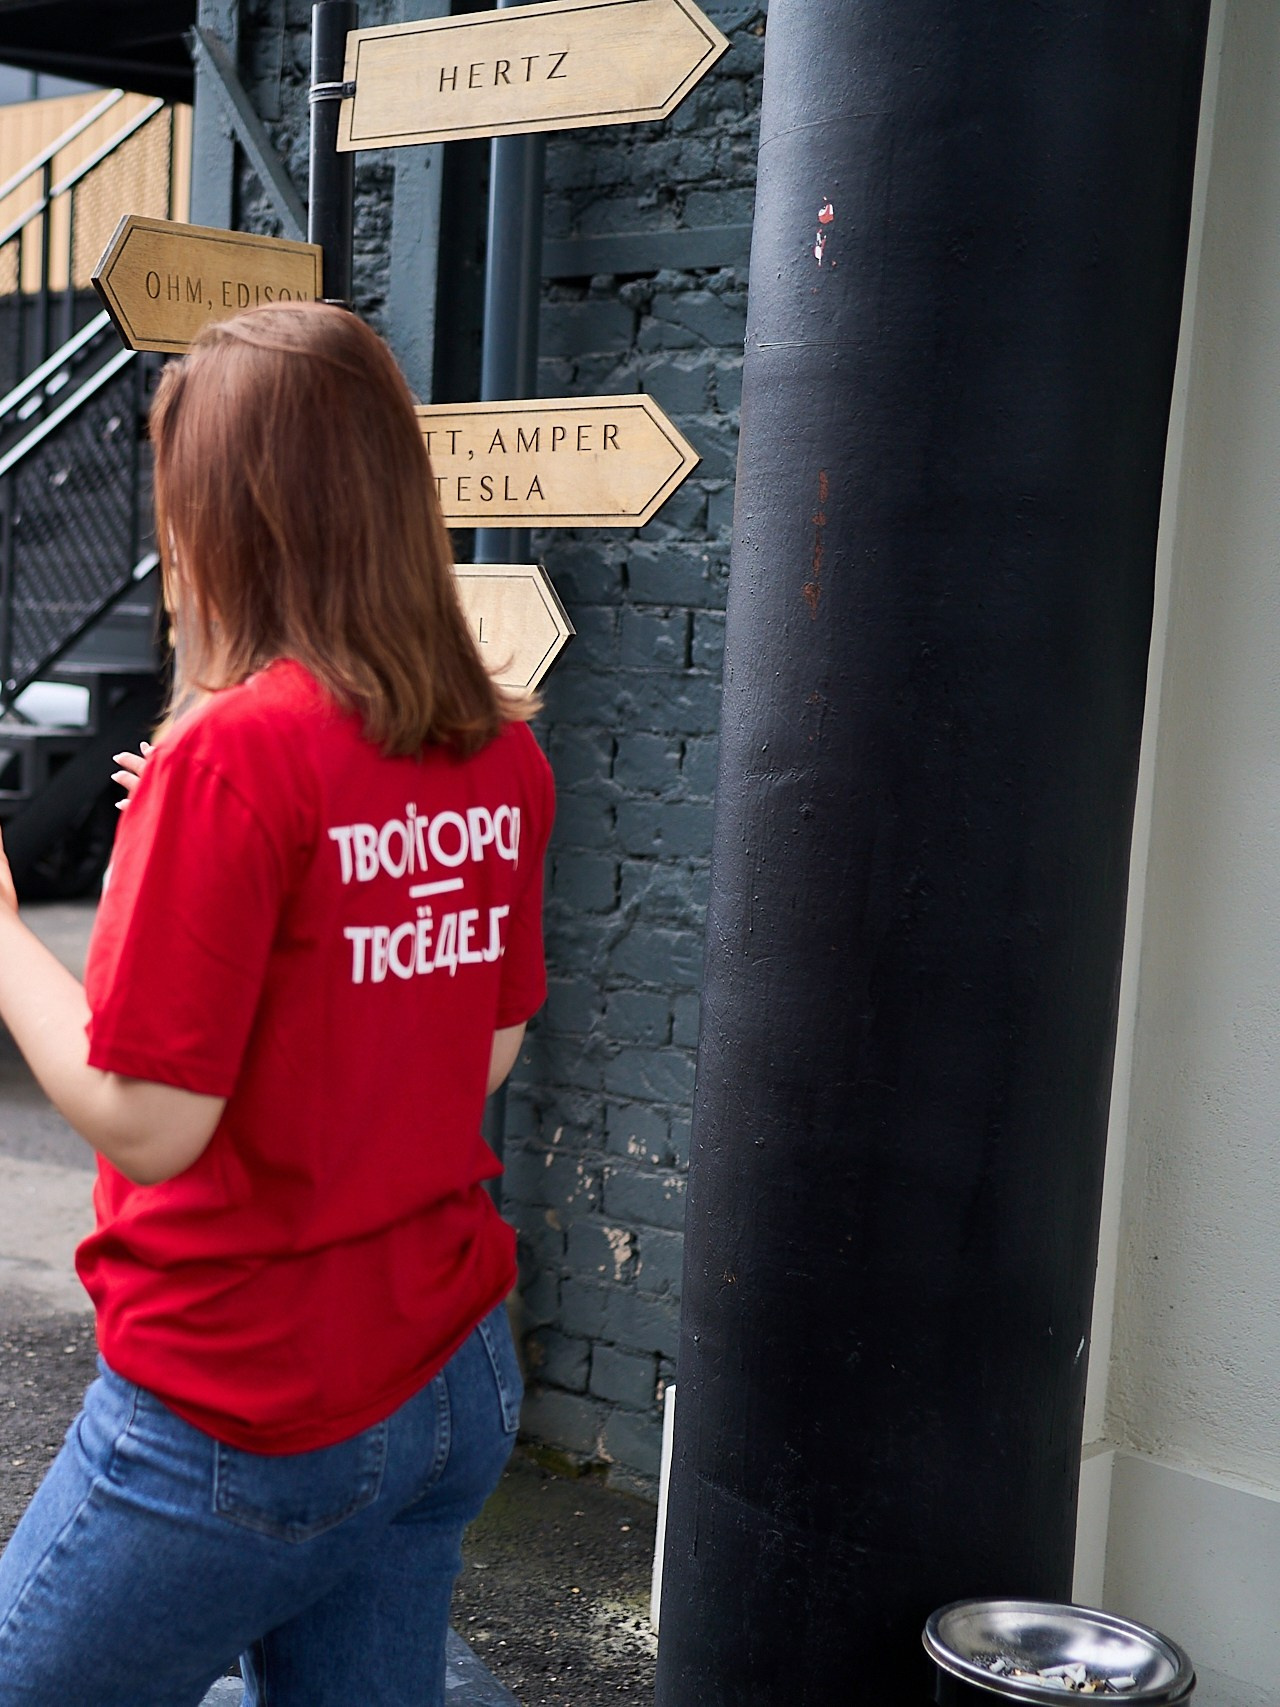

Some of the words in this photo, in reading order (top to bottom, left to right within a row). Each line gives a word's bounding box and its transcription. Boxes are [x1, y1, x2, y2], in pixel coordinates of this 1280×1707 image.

[439, 51, 569, 93] HERTZ
[146, 271, 213, 311] OHM,
[488, 424, 621, 454] AMPER
[434, 474, 546, 502] TESLA
[343, 905, 434, 984] ТВОЁ
[433, 904, 510, 978] ДЕЛ
